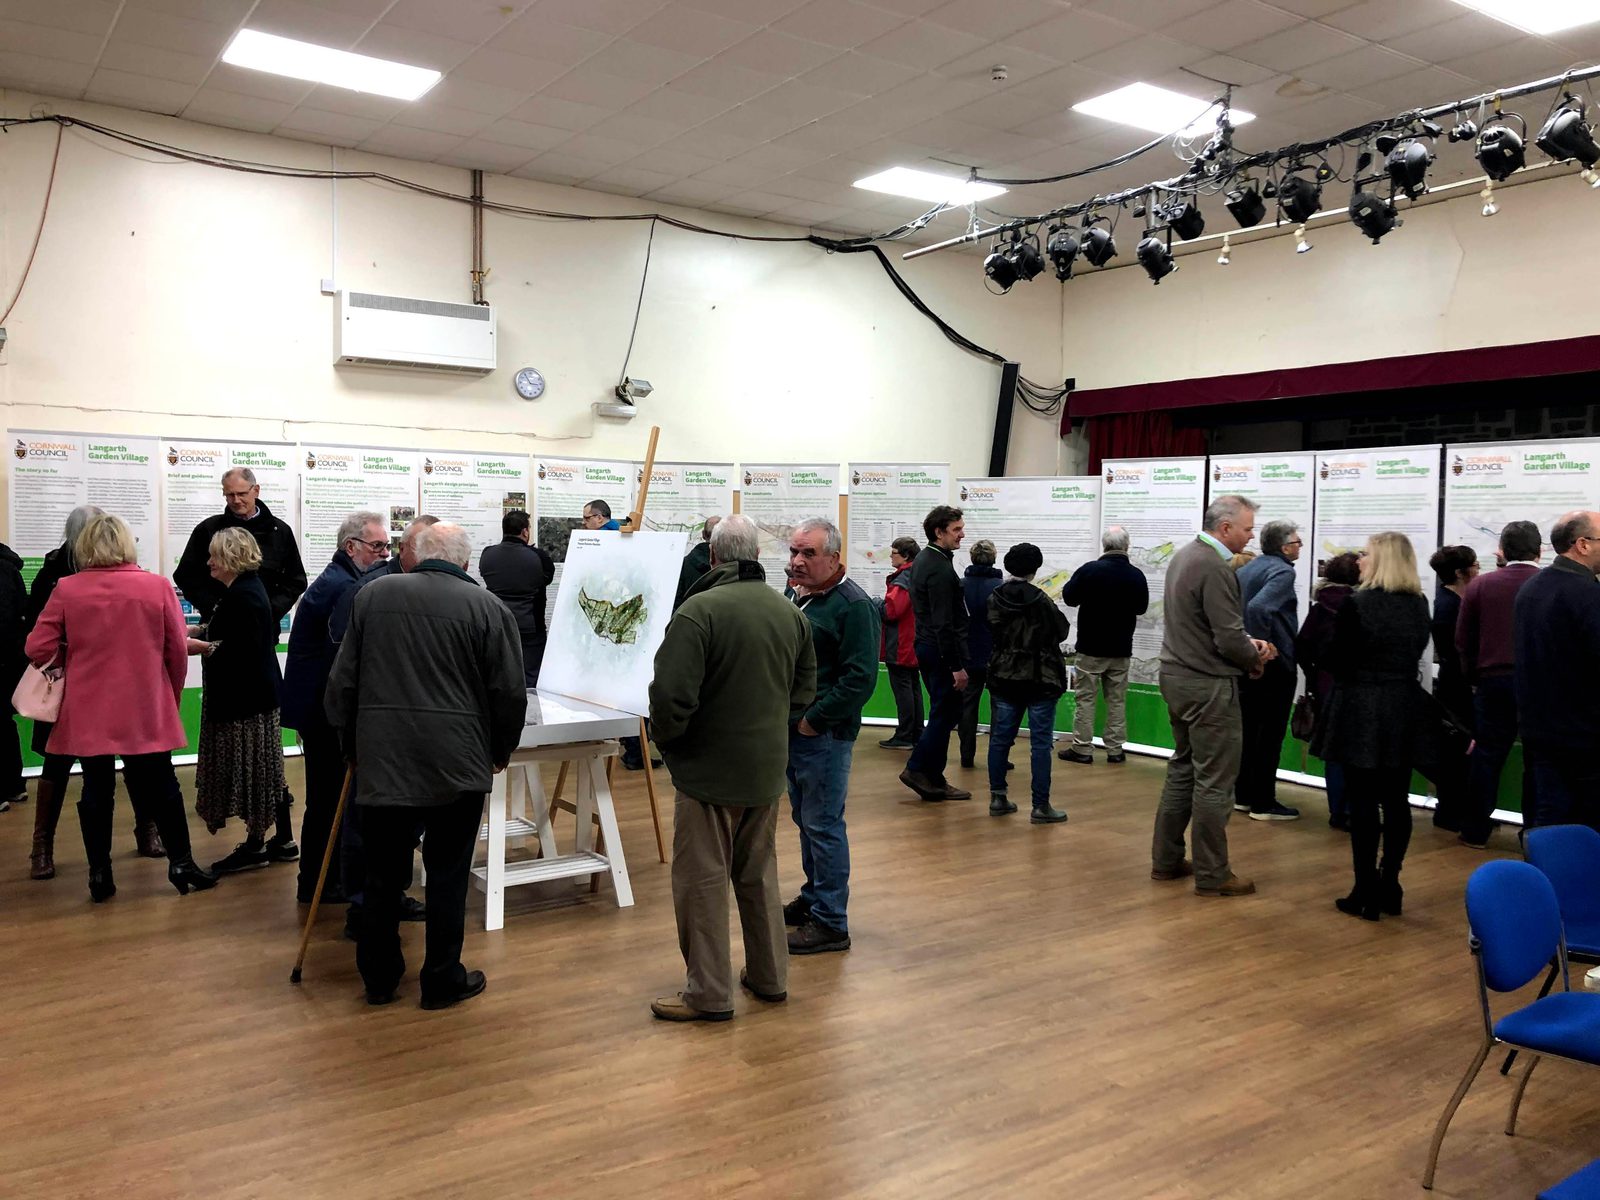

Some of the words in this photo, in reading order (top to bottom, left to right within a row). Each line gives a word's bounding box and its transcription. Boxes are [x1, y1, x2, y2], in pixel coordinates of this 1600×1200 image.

[29, 442, 78, 451] CORNWALL
[88, 444, 126, 452] Langarth
[121, 454, 149, 462] Village
[1524, 452, 1566, 461] Langarth
[1559, 462, 1590, 470] Village
